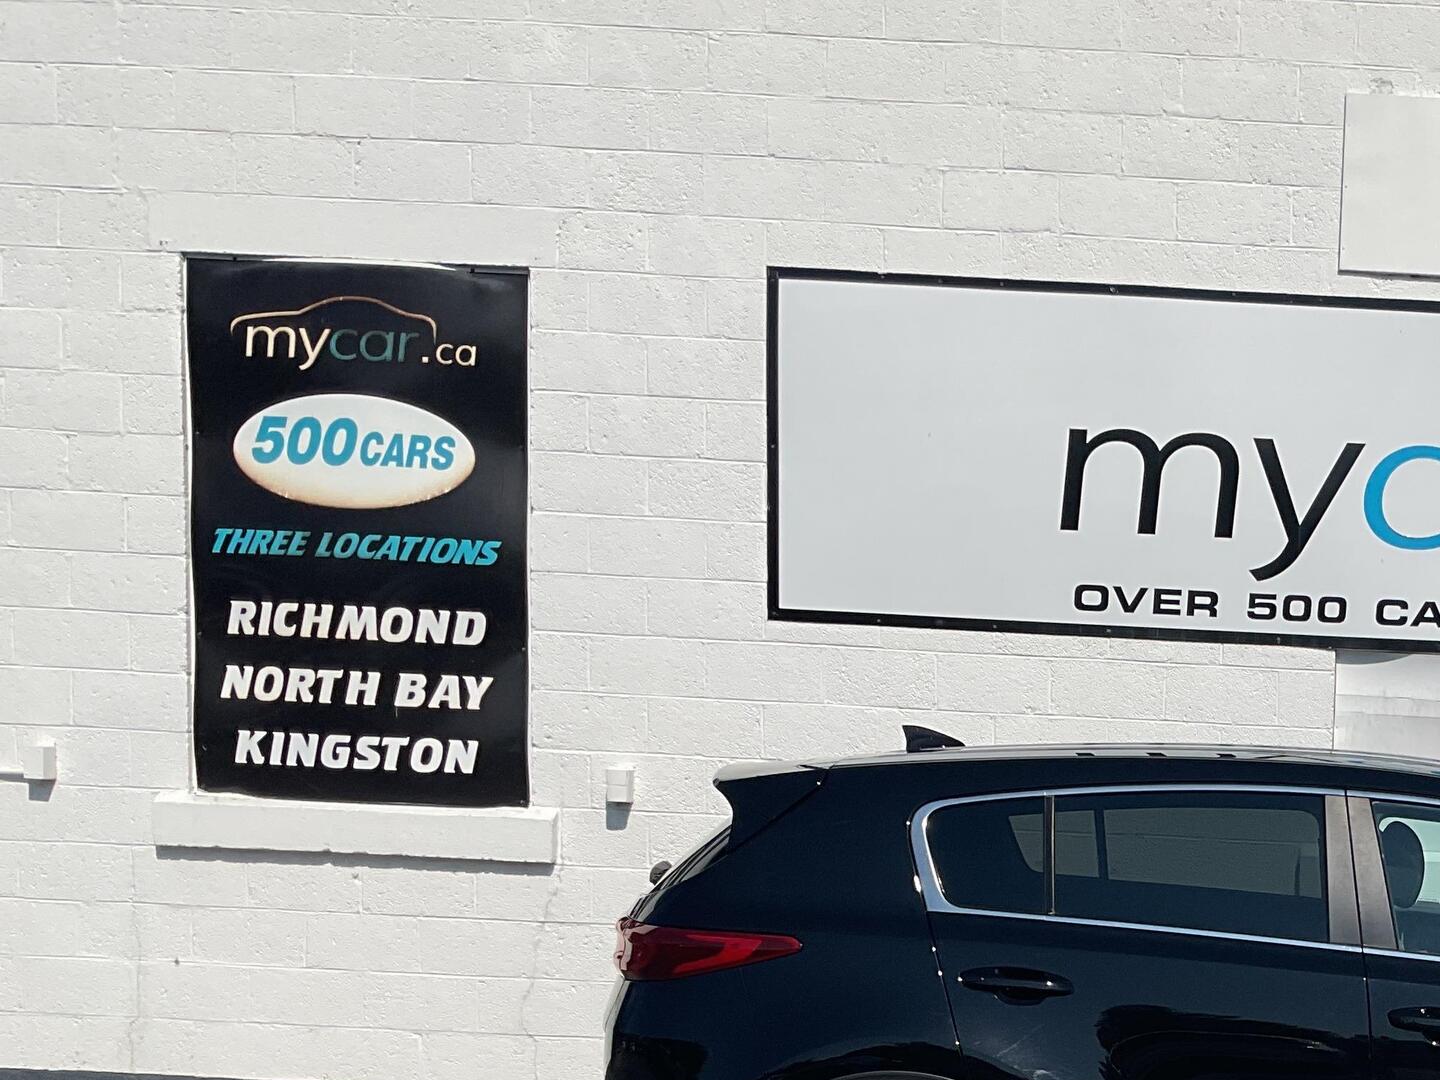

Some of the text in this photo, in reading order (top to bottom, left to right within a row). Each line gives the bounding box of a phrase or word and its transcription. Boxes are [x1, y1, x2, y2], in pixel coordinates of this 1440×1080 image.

[245, 324, 477, 370] mycar.ca
[251, 416, 456, 470] 500 CARS
[211, 528, 501, 566] THREE LOCATIONS
[227, 600, 487, 646] RICHMOND
[1073, 584, 1218, 618] OVER
[1246, 594, 1347, 624] 500
[220, 664, 494, 711] NORTH BAY
[234, 729, 479, 775] KINGSTON
